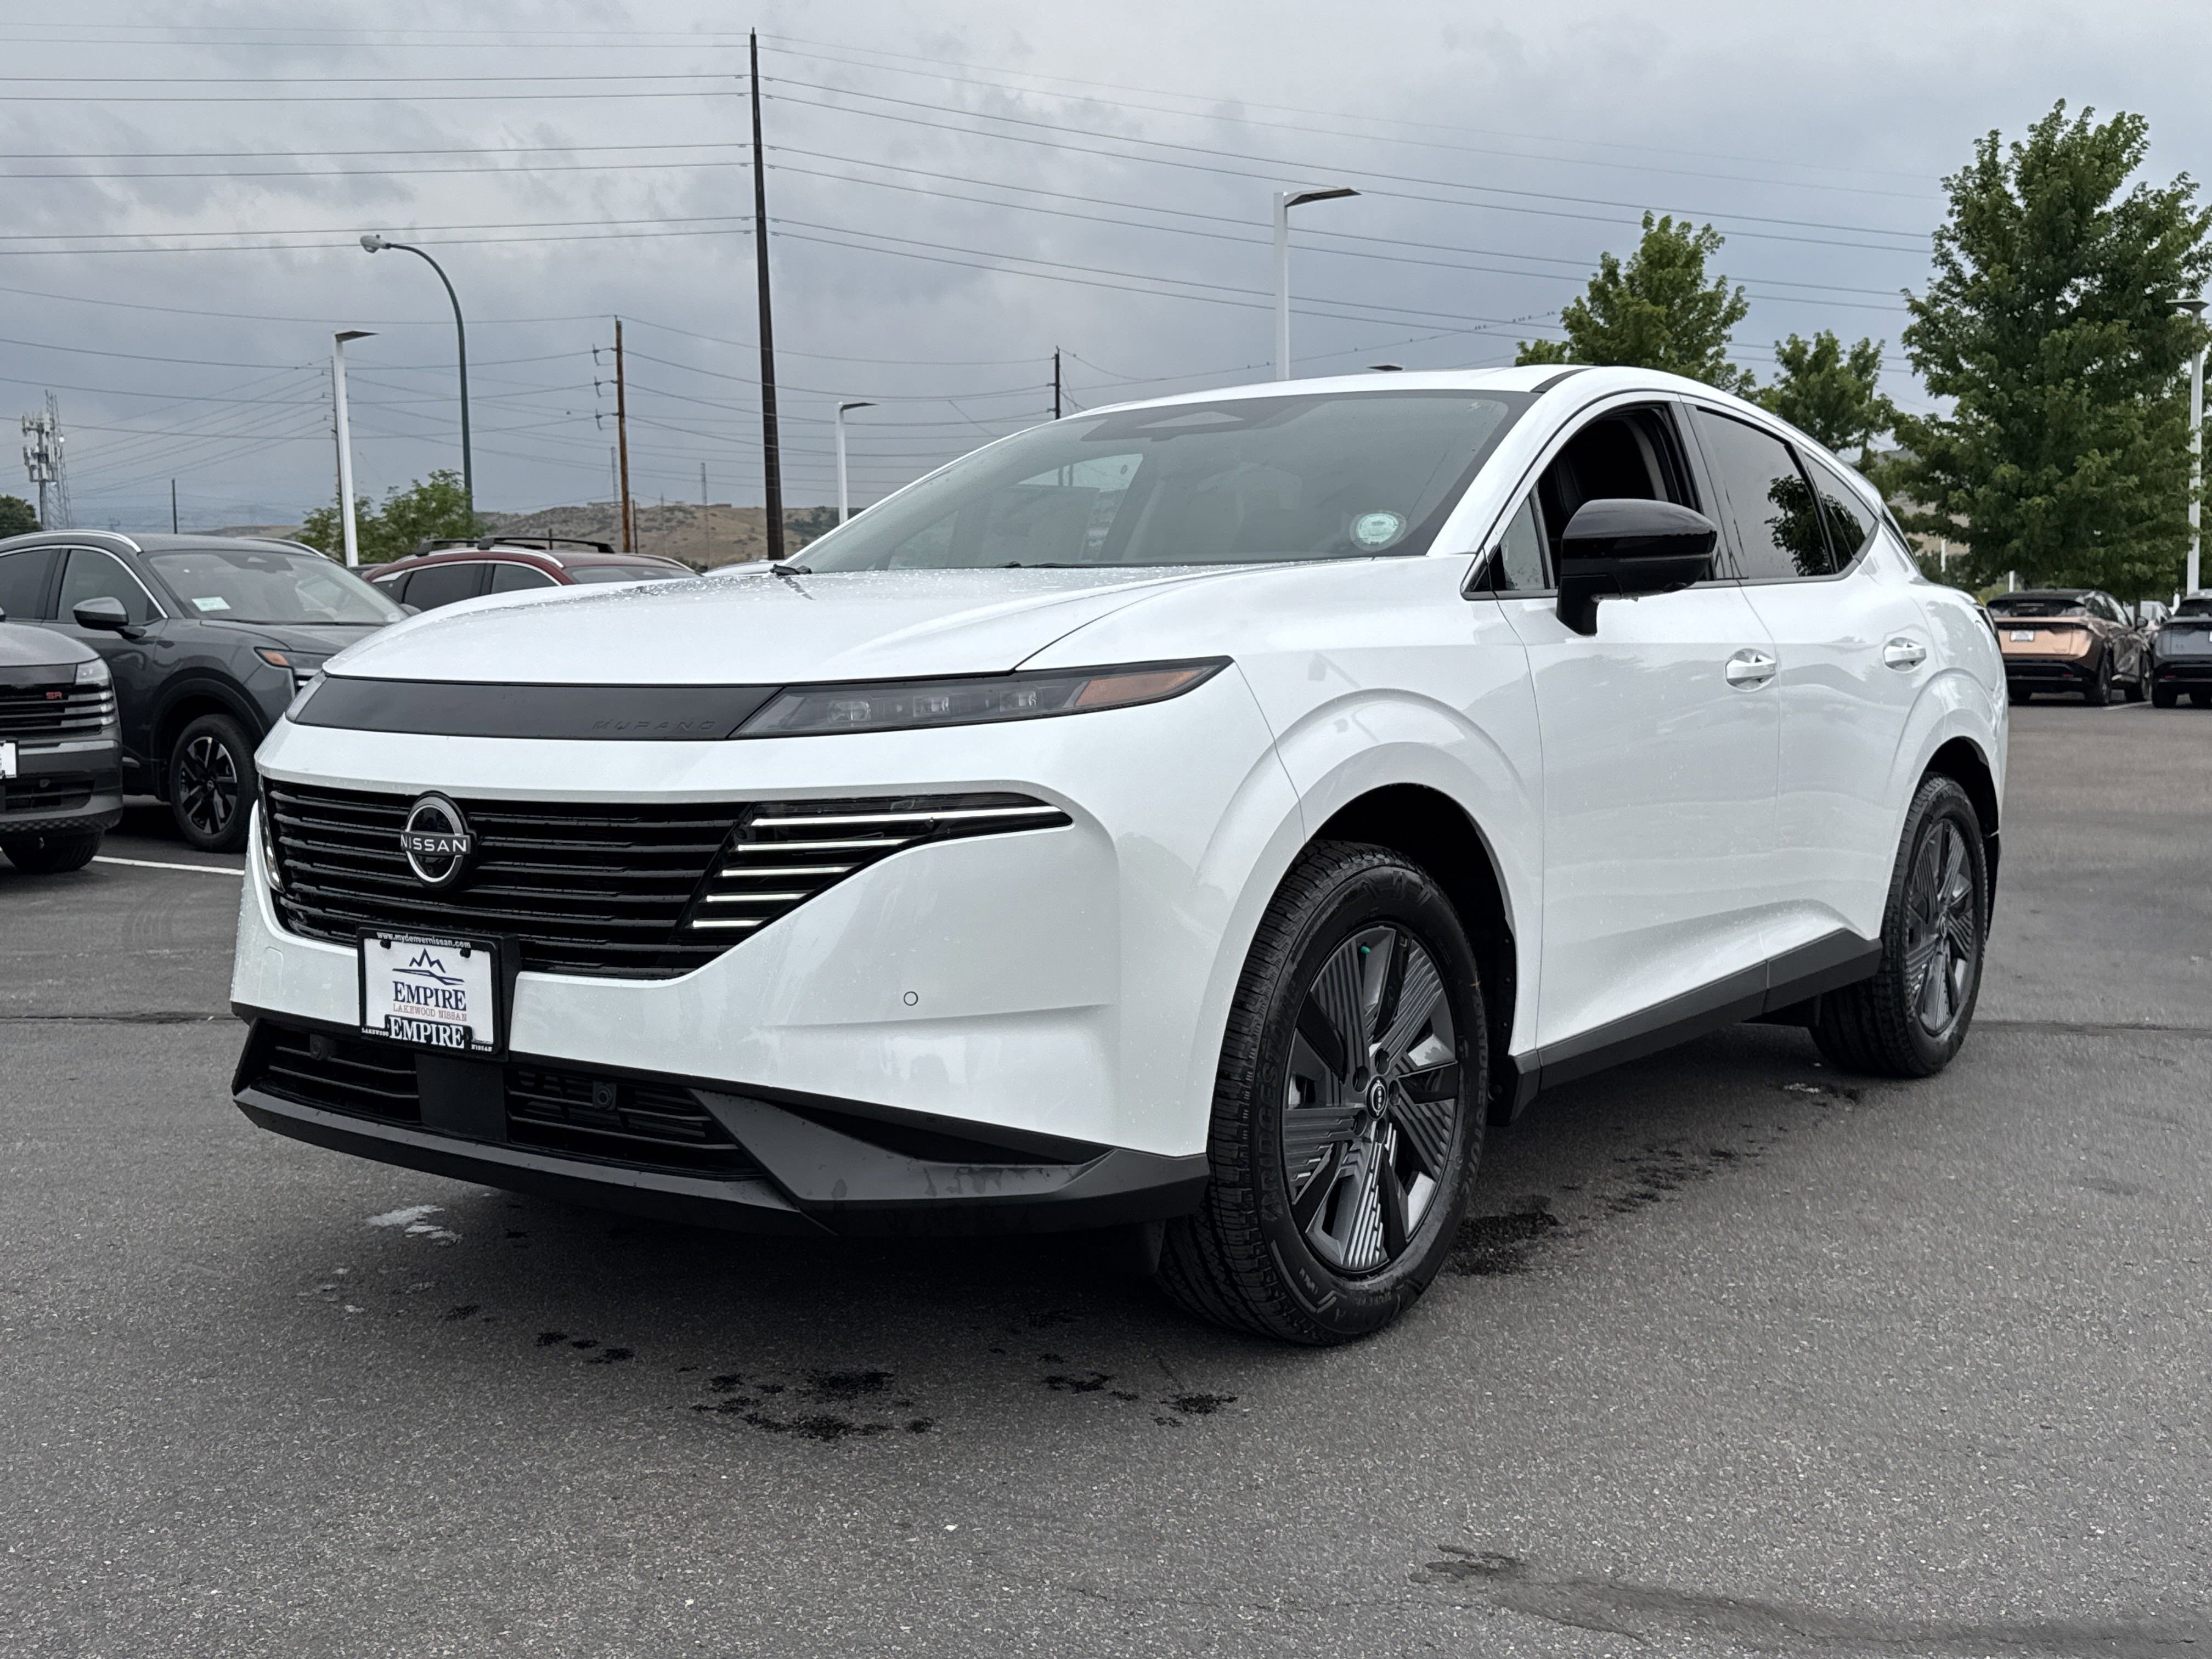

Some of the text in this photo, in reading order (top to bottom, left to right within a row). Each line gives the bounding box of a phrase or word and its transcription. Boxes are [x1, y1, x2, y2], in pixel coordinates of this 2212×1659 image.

[46, 691, 62, 699] SR
[591, 719, 716, 731] MURANO
[400, 834, 466, 852] NISSAN
[376, 932, 471, 949] www.mydenvernissan.com
[392, 980, 466, 1011] EMPIRE
[393, 1003, 467, 1022] LAKEWOOD NISSAN
[388, 1015, 465, 1049] EMPIRE
